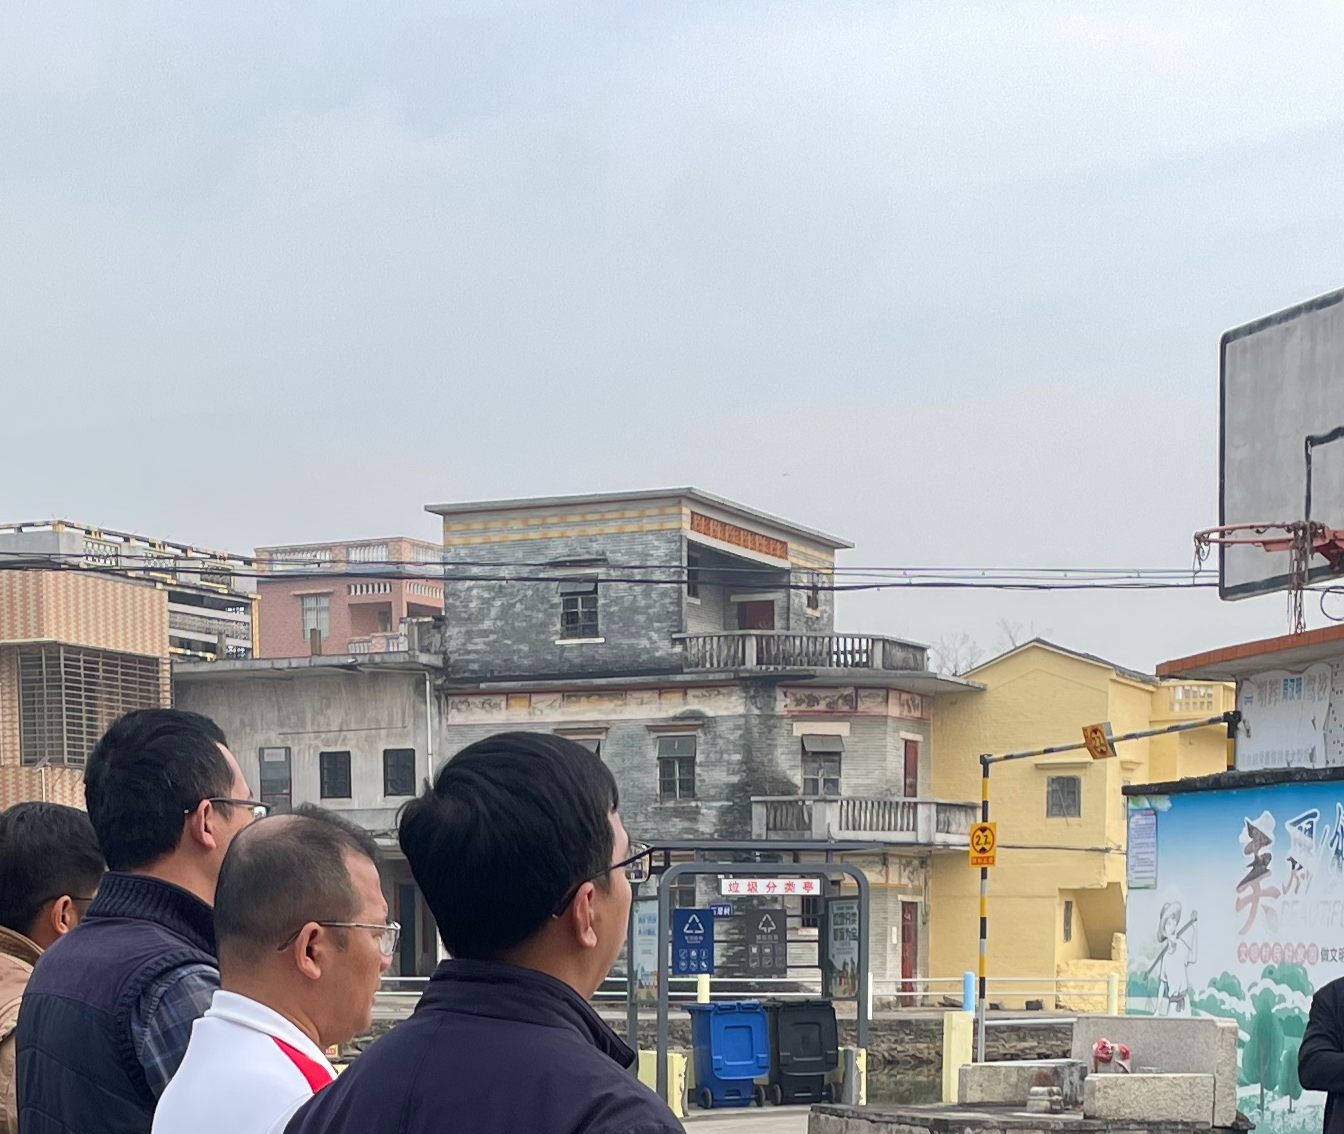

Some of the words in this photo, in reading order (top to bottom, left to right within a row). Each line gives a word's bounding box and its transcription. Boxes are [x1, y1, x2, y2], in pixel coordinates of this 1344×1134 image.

[728, 881, 814, 893] 垃圾分类亭
